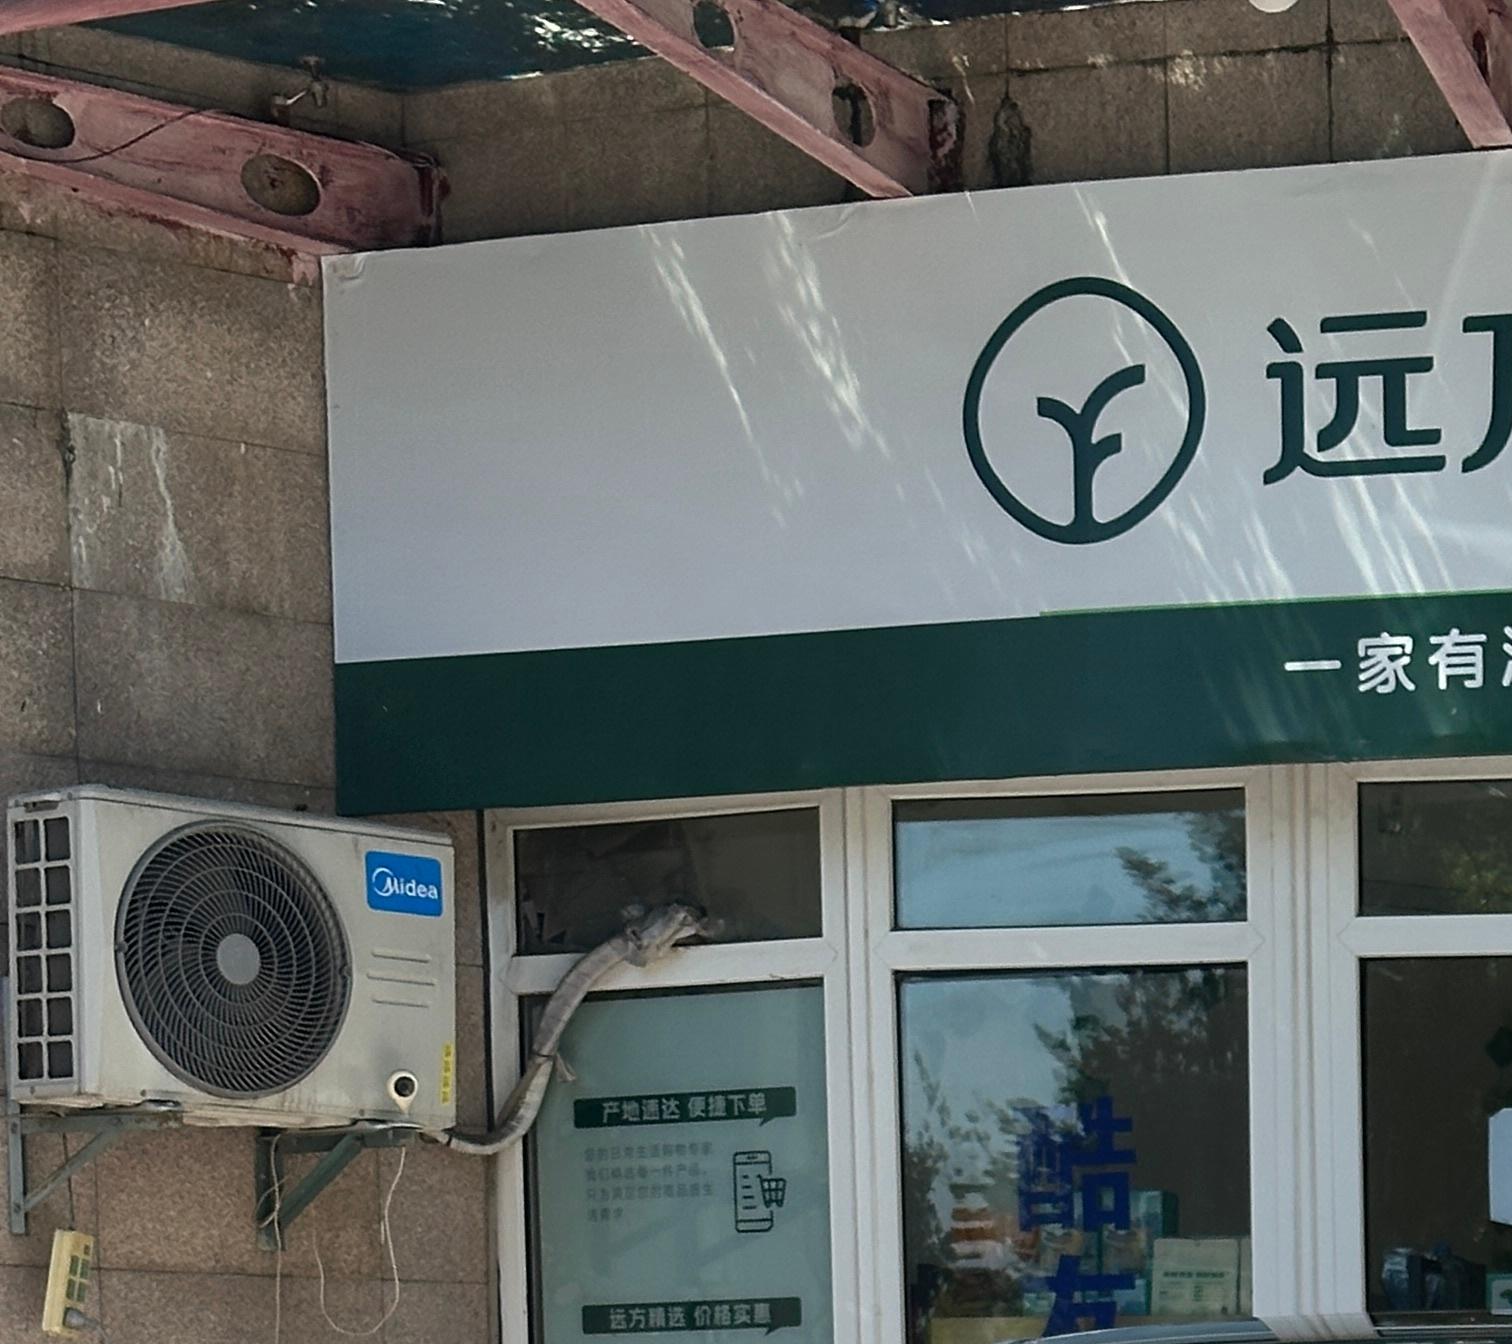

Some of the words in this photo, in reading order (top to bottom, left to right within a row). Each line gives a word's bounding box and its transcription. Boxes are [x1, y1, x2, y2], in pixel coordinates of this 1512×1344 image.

[372, 867, 439, 899] Midea
[610, 1305, 687, 1330] 远方精选
